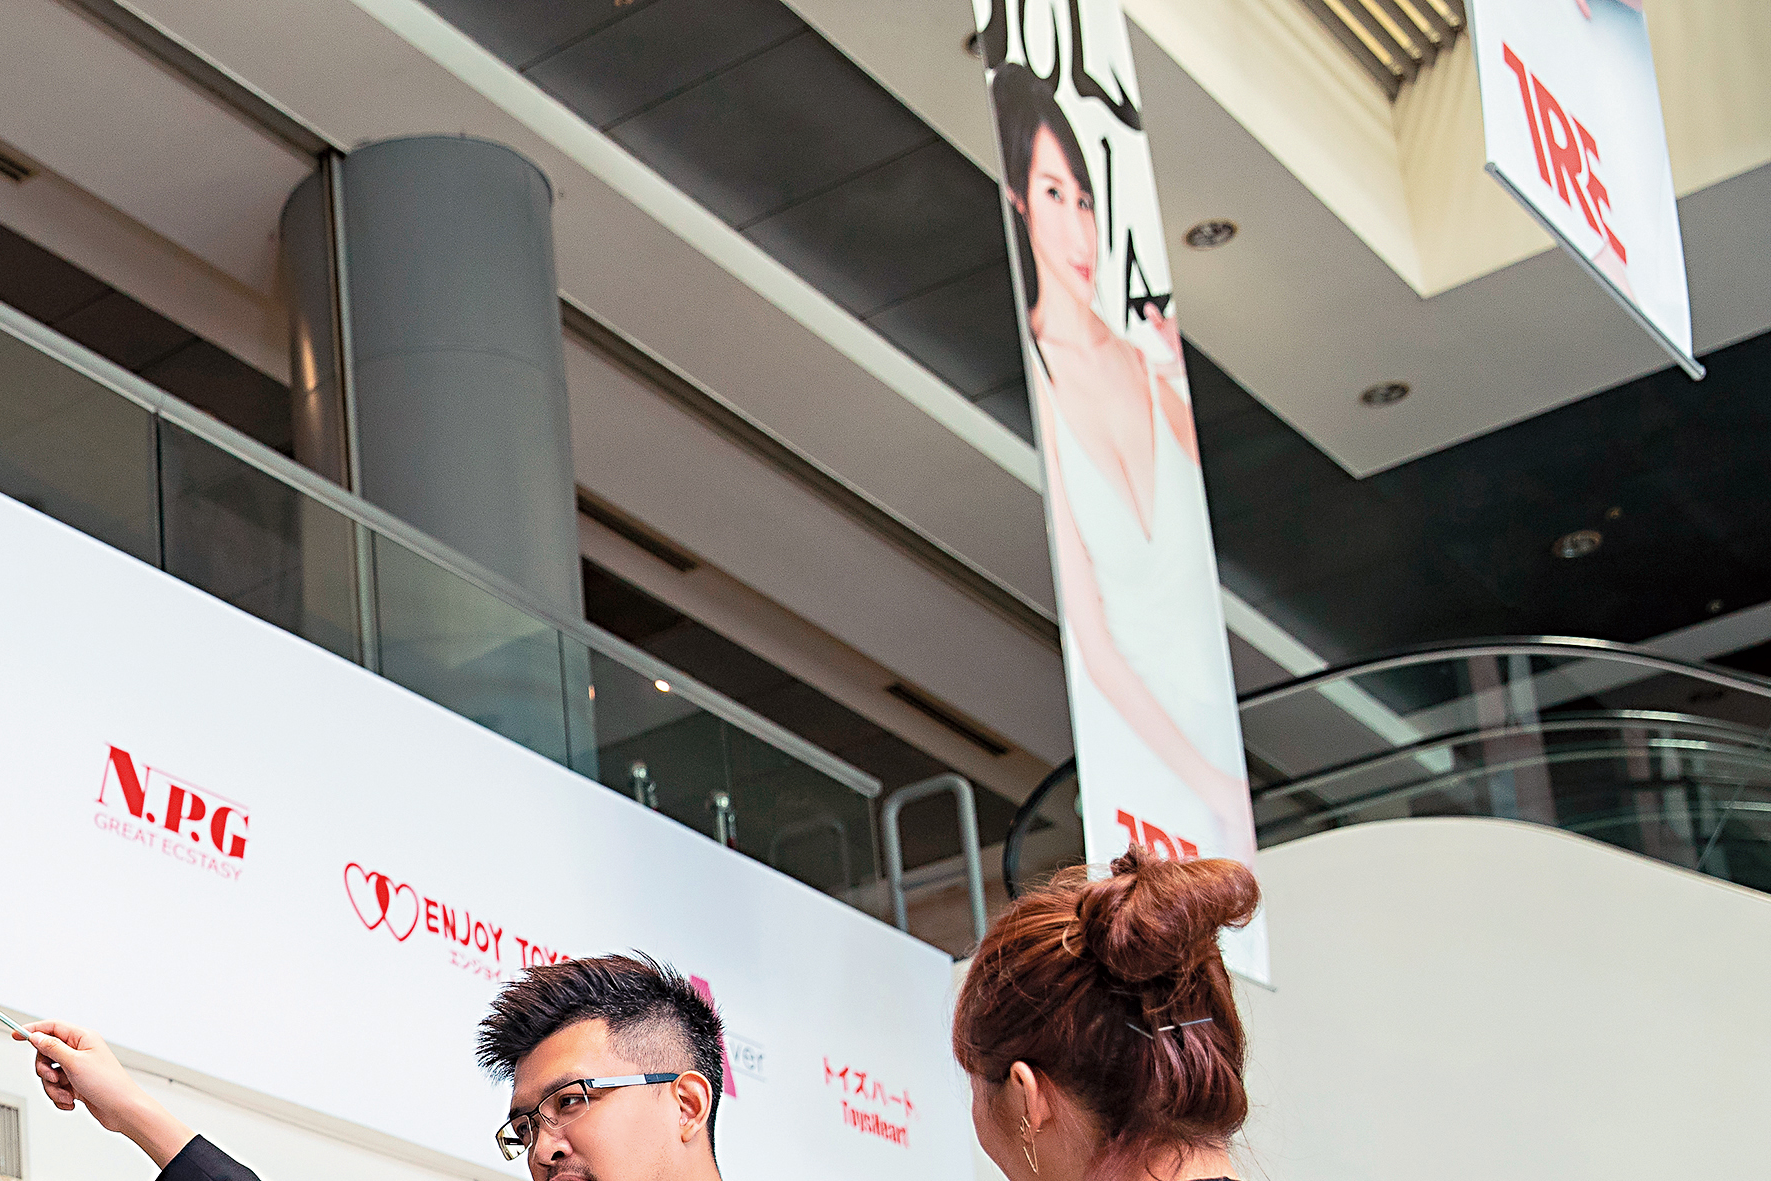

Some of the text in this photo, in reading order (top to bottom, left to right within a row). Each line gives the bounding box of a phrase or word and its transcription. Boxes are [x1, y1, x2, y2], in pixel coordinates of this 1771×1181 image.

[1502, 41, 1627, 266] TRE
[94, 812, 243, 881] GREAT ECSTASY
[95, 743, 249, 860] N.P.G
[424, 897, 571, 968] ENJOY TOY
